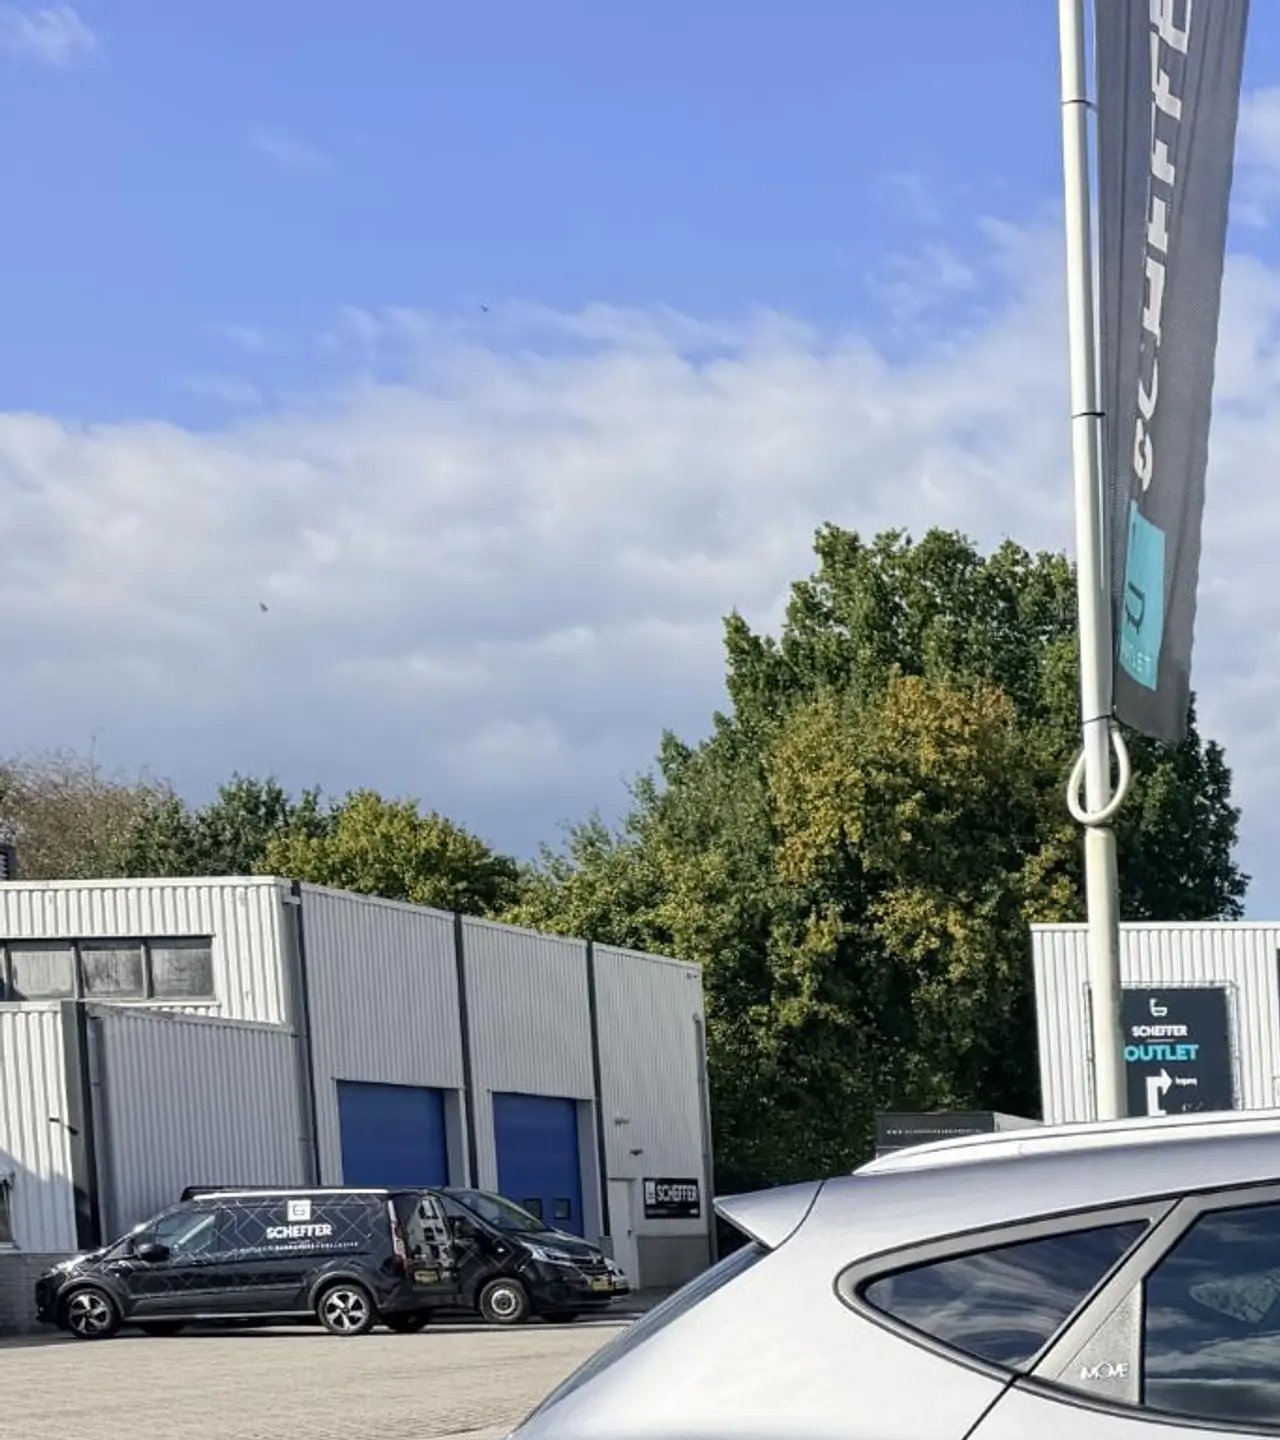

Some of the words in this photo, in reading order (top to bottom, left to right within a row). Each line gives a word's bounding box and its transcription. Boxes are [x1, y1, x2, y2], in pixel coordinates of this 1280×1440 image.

[1132, 1025, 1188, 1037] SCHEFFER
[1125, 1044, 1199, 1061] OUTLET
[266, 1223, 332, 1239] SCHEFFER
